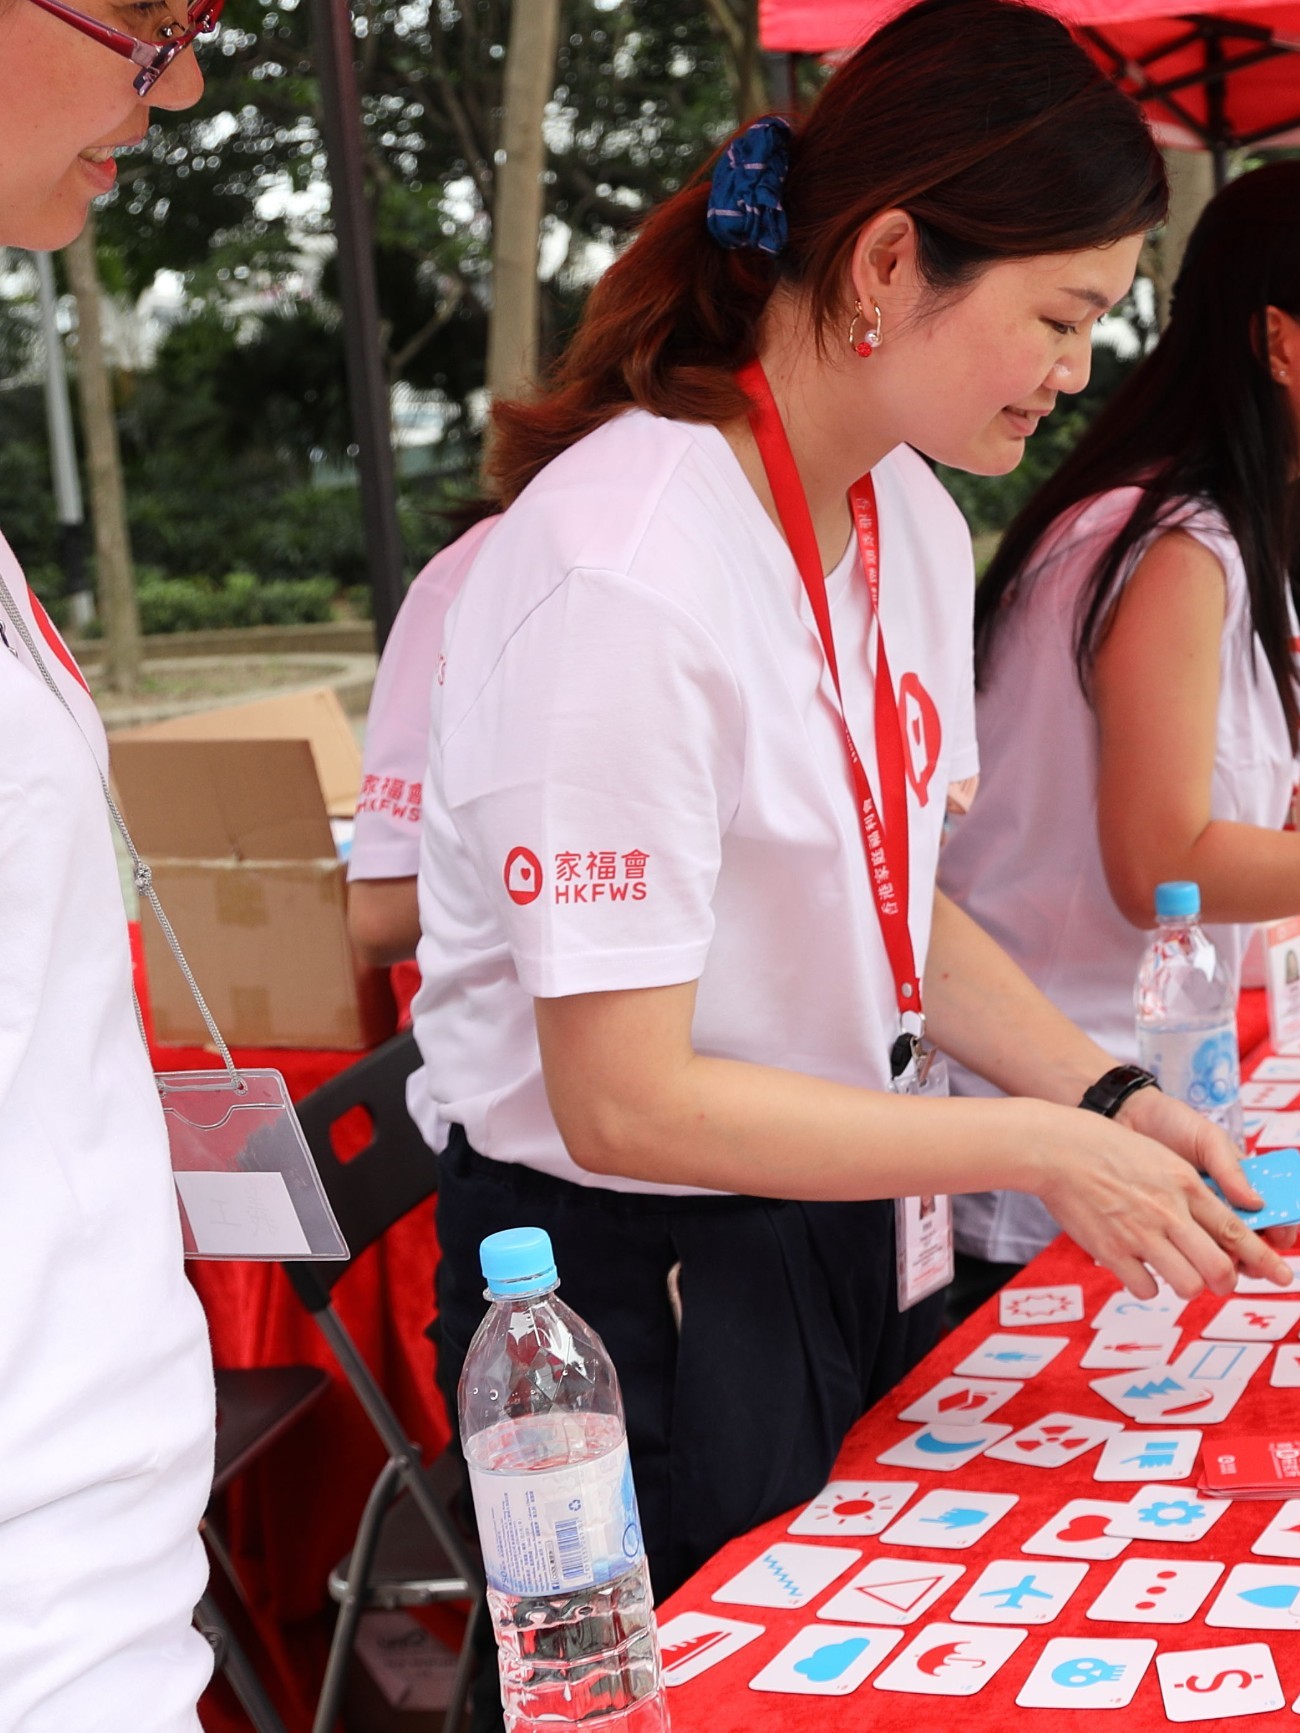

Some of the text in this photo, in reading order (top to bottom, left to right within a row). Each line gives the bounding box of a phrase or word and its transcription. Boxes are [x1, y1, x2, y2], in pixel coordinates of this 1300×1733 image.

[356, 798, 421, 822] HKFWS
[554, 848, 650, 882] 家福會
[863, 798, 899, 916] 香港家庭福利會
[554, 881, 648, 904] HKFWS
